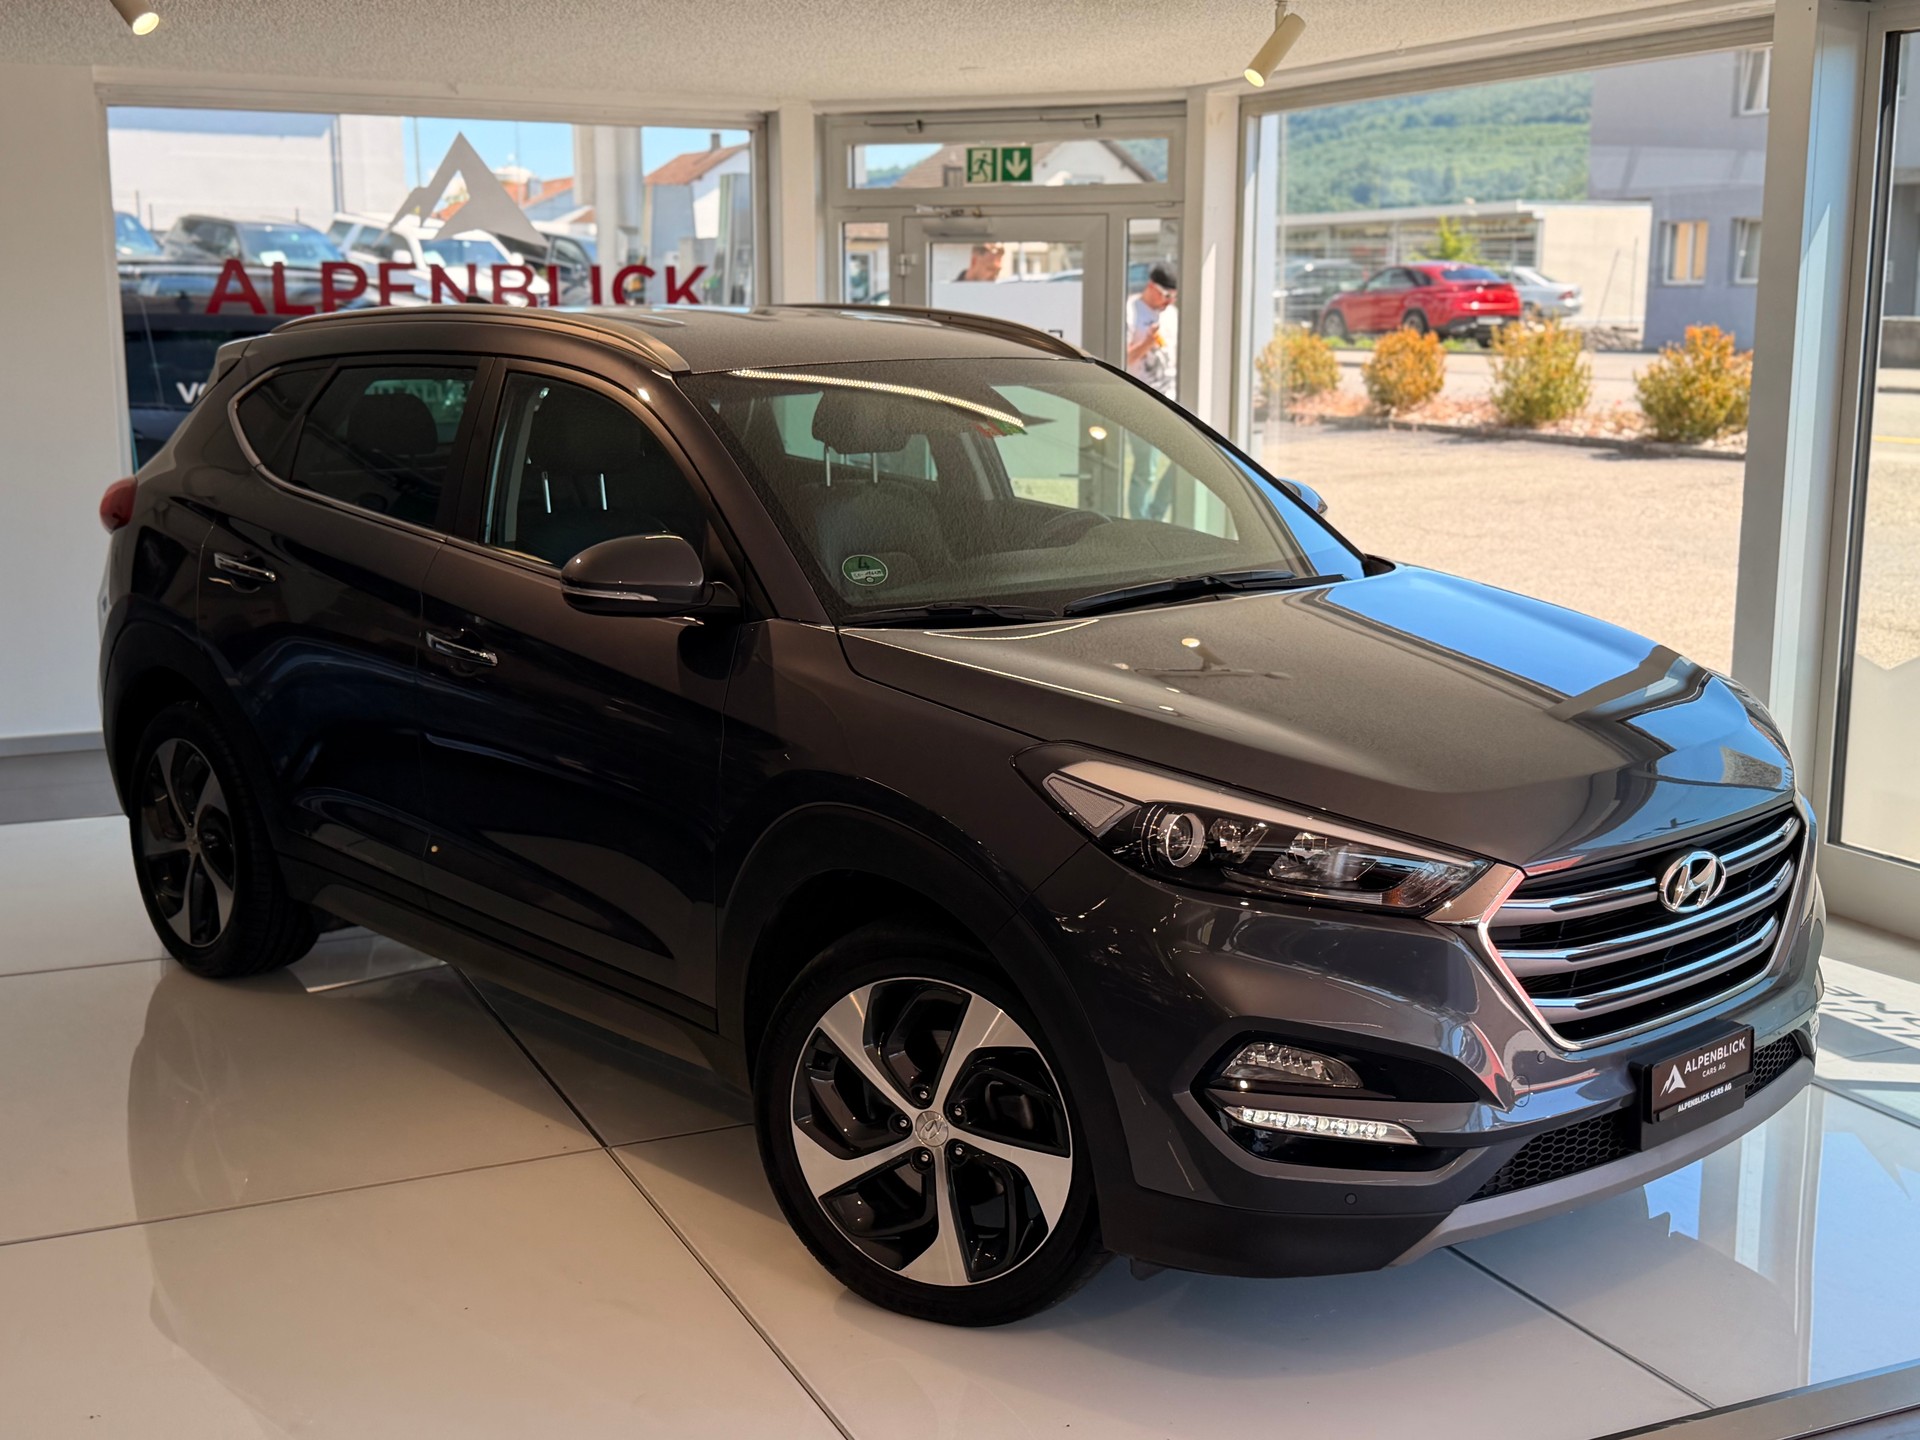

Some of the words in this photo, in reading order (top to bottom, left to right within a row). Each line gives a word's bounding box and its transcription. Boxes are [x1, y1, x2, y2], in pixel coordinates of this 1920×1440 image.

[1684, 1037, 1746, 1075] ALPENBLICK
[1702, 1066, 1717, 1078] CARS
[1718, 1062, 1727, 1071] AG
[1677, 1092, 1710, 1113] ALPENBLICK
[1709, 1086, 1724, 1098] CARS
[1724, 1082, 1733, 1092] AG
